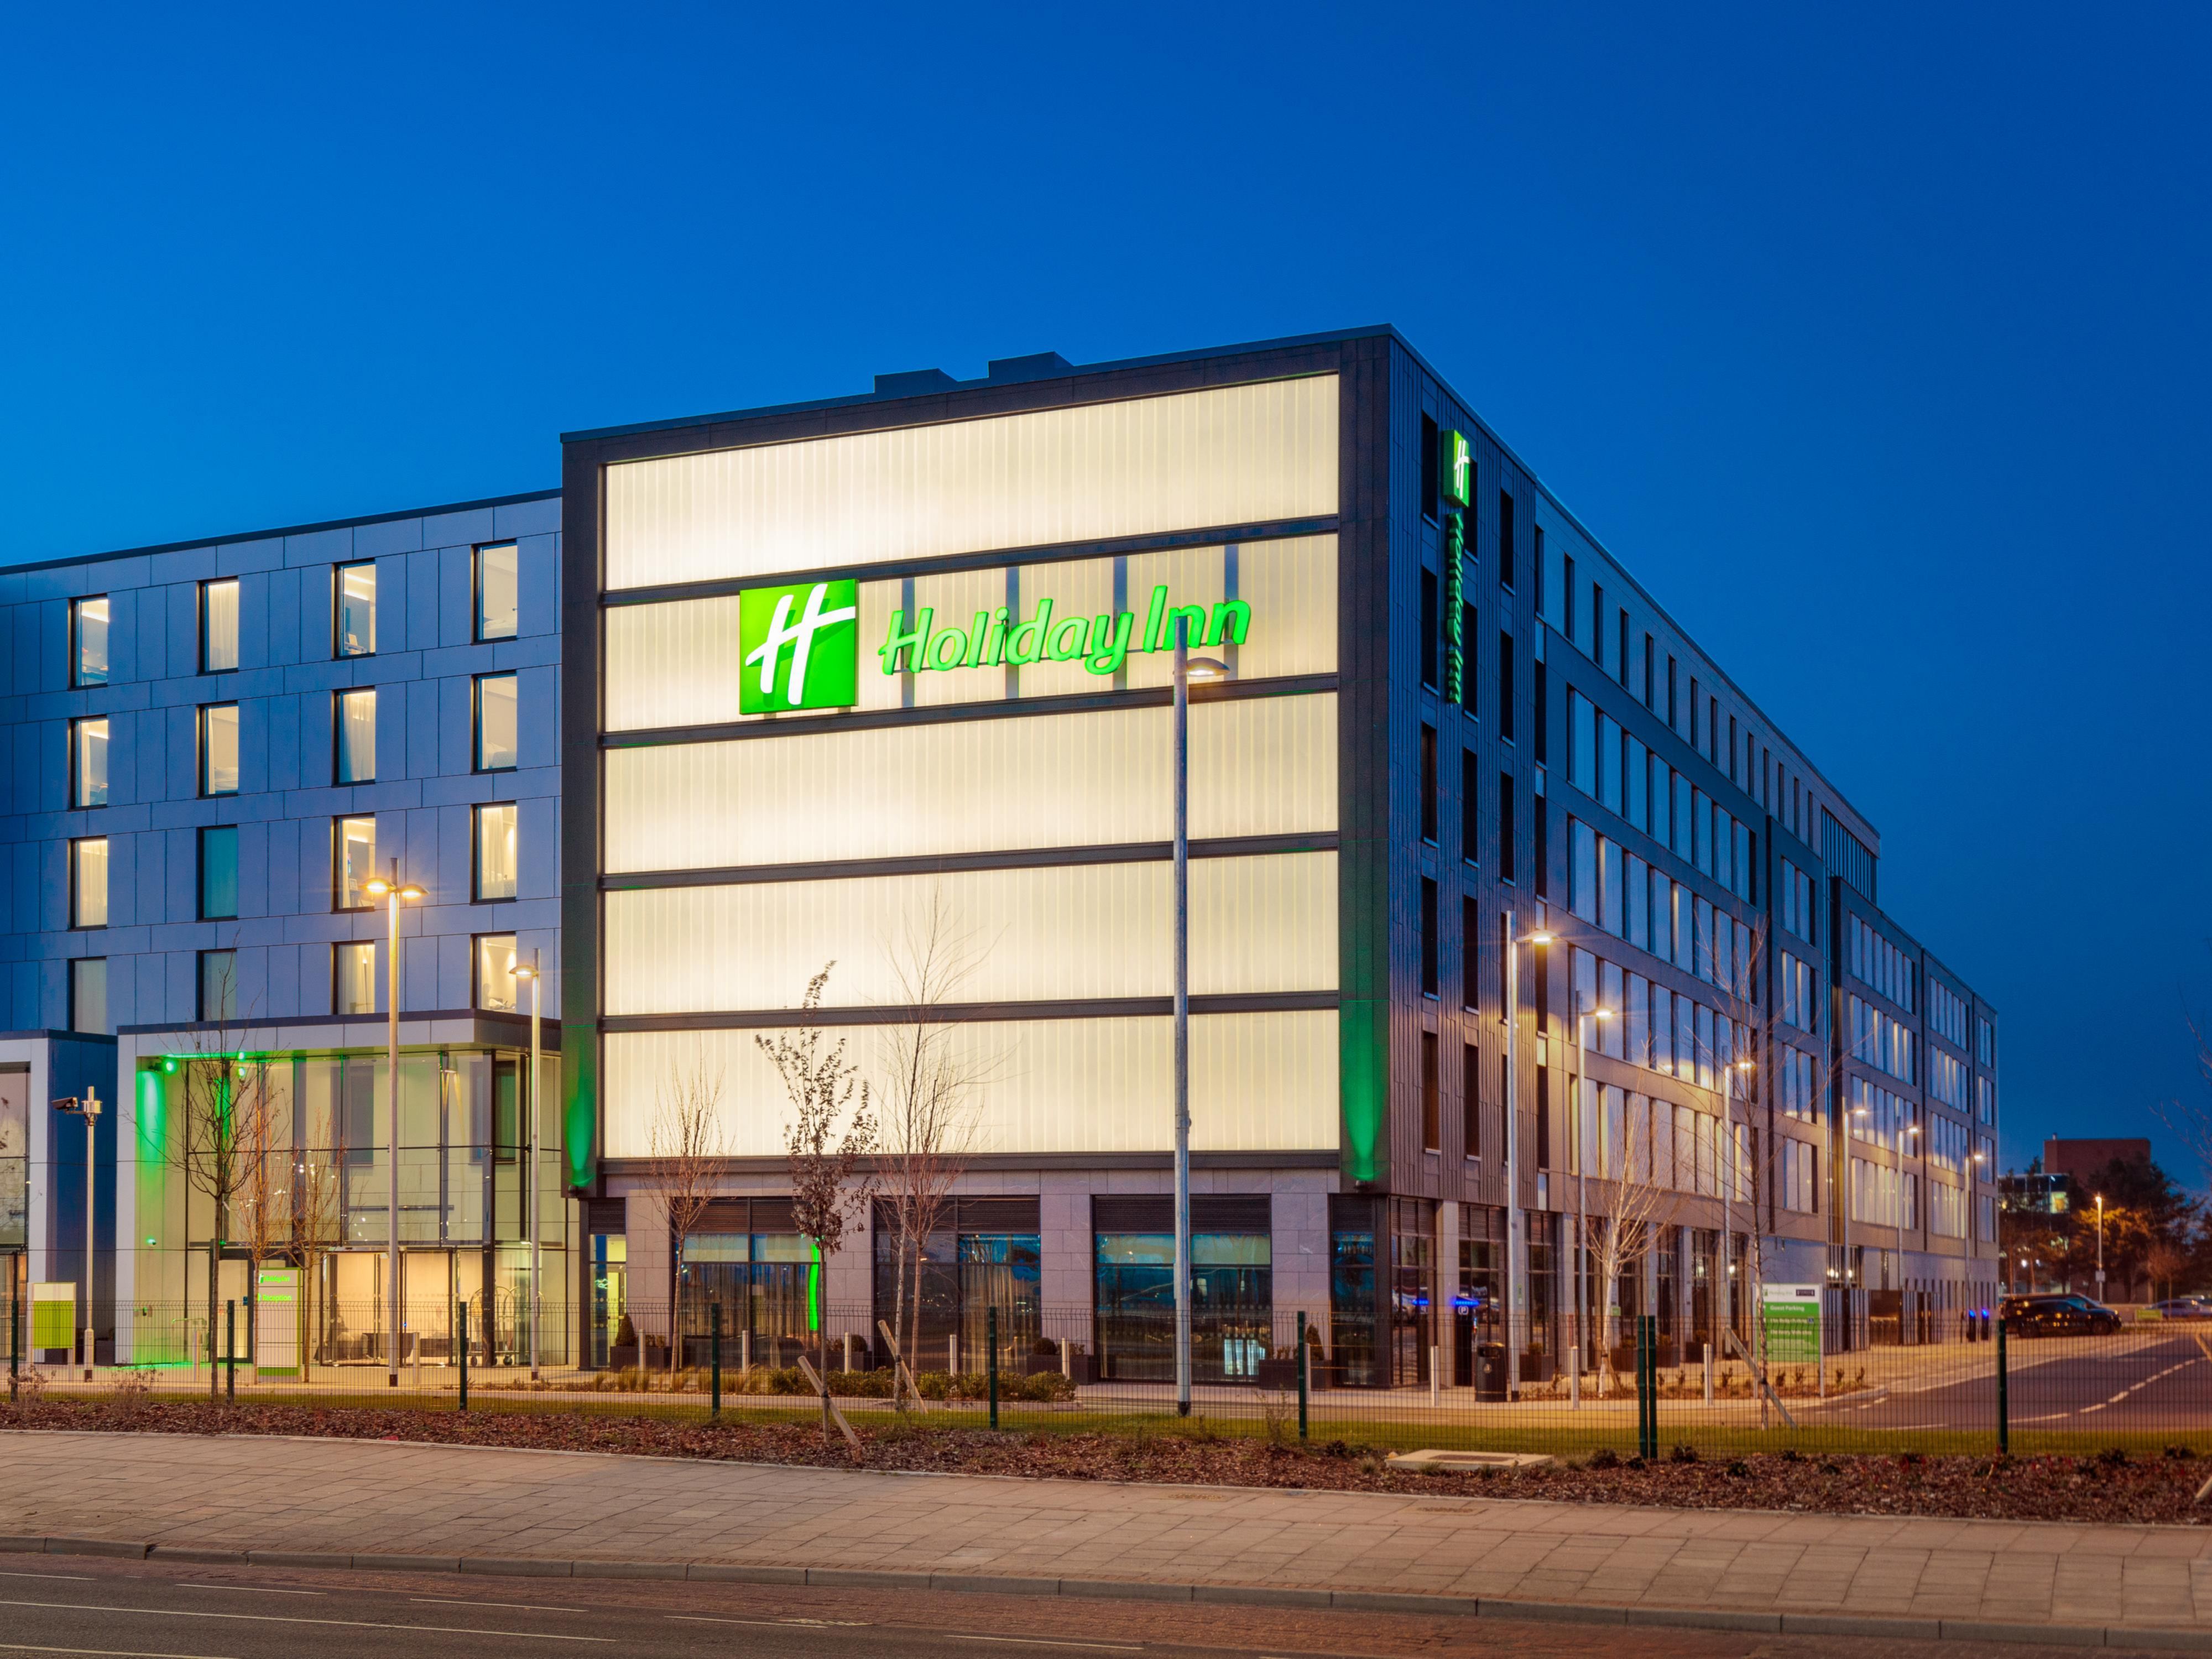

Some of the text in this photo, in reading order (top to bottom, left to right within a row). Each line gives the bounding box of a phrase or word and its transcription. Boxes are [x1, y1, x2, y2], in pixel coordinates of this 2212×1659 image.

[878, 598, 1134, 675] Holiday
[1143, 585, 1251, 653] Inn
[263, 1295, 292, 1303] Reception
